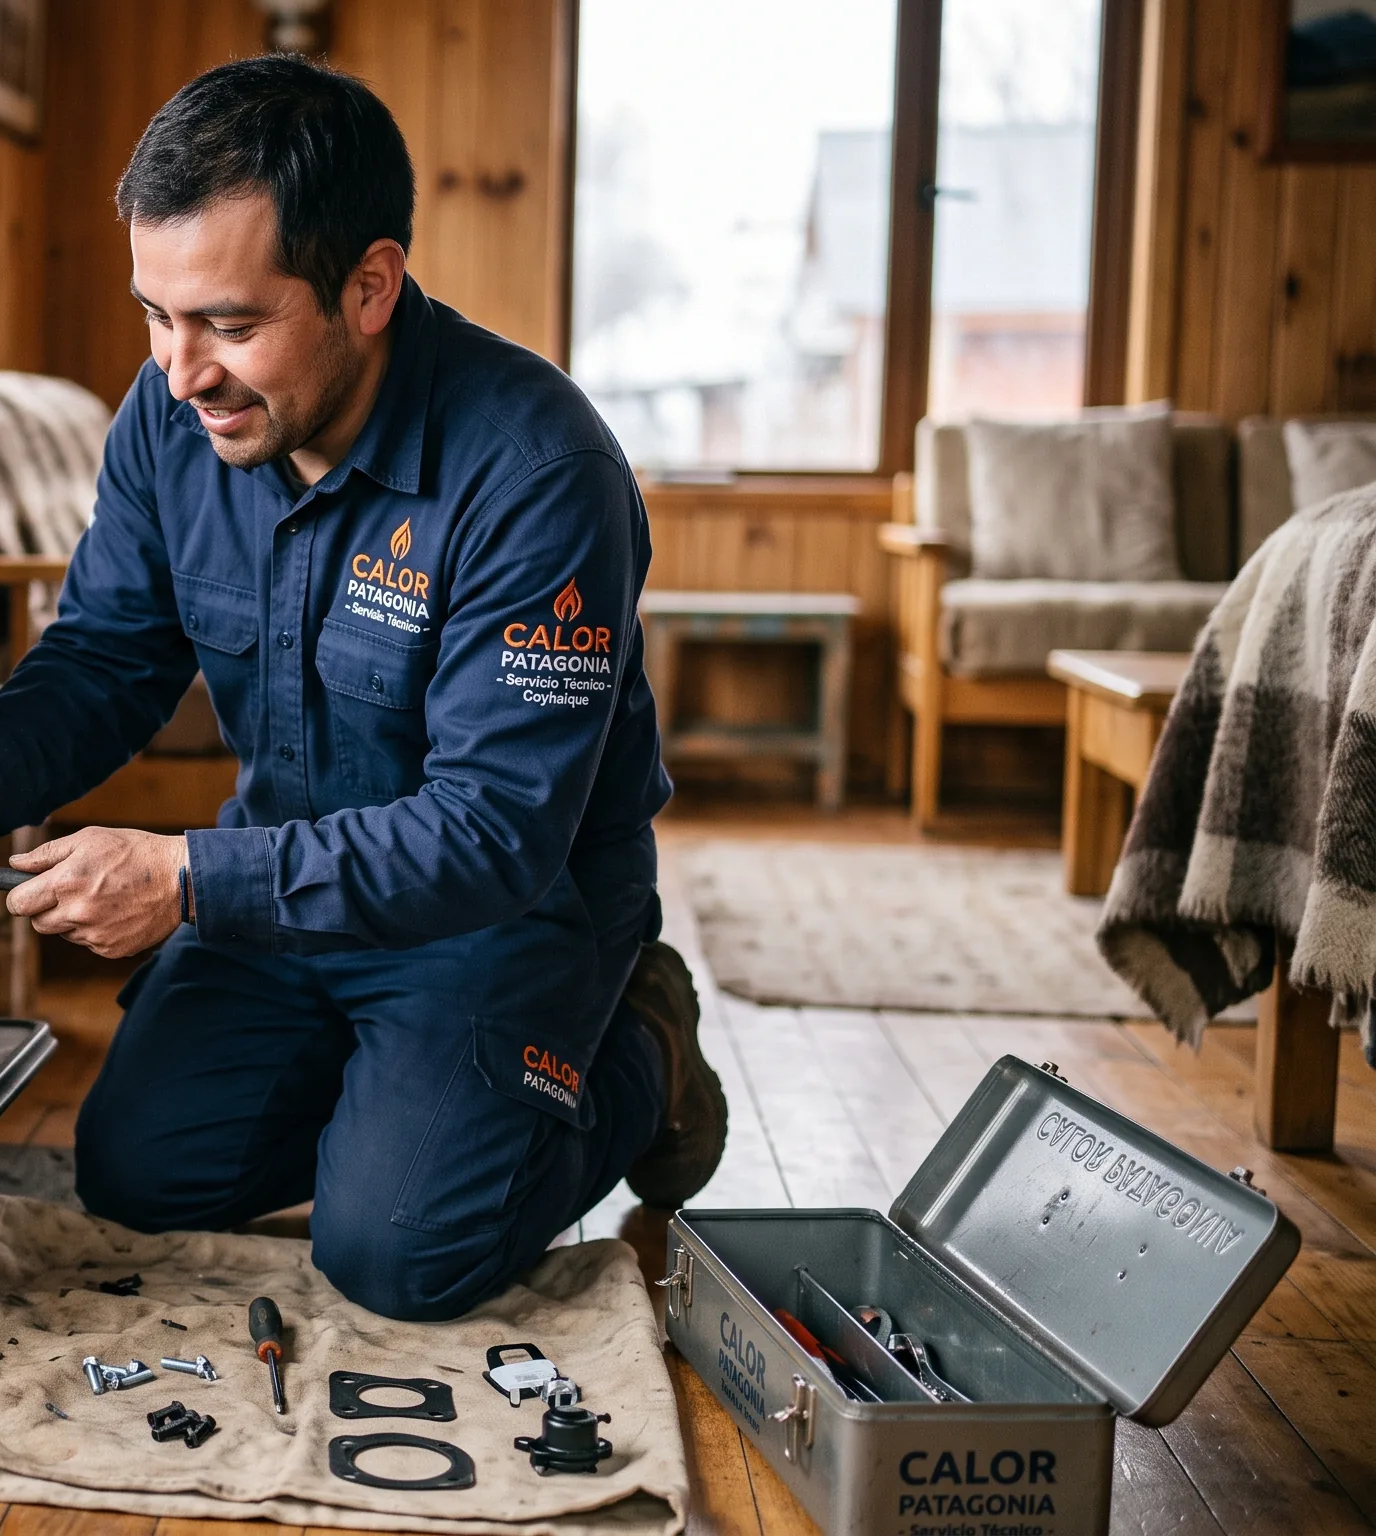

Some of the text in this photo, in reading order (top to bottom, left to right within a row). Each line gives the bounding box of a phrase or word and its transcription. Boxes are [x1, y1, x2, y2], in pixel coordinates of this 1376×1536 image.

[352, 554, 429, 600] CALOR
[347, 580, 430, 619] PATAGONIA
[386, 612, 421, 634] Técnico
[504, 623, 611, 653] CALOR
[501, 650, 611, 674] PATAGONIA
[505, 673, 559, 689] Servicio
[563, 677, 605, 691] Técnico
[523, 689, 589, 708] Coyhaique
[523, 1045, 580, 1094] CALOR
[720, 1311, 766, 1391] CALOR
[899, 1450, 1057, 1486] CALOR
[898, 1494, 1056, 1516] PATAGONIA
